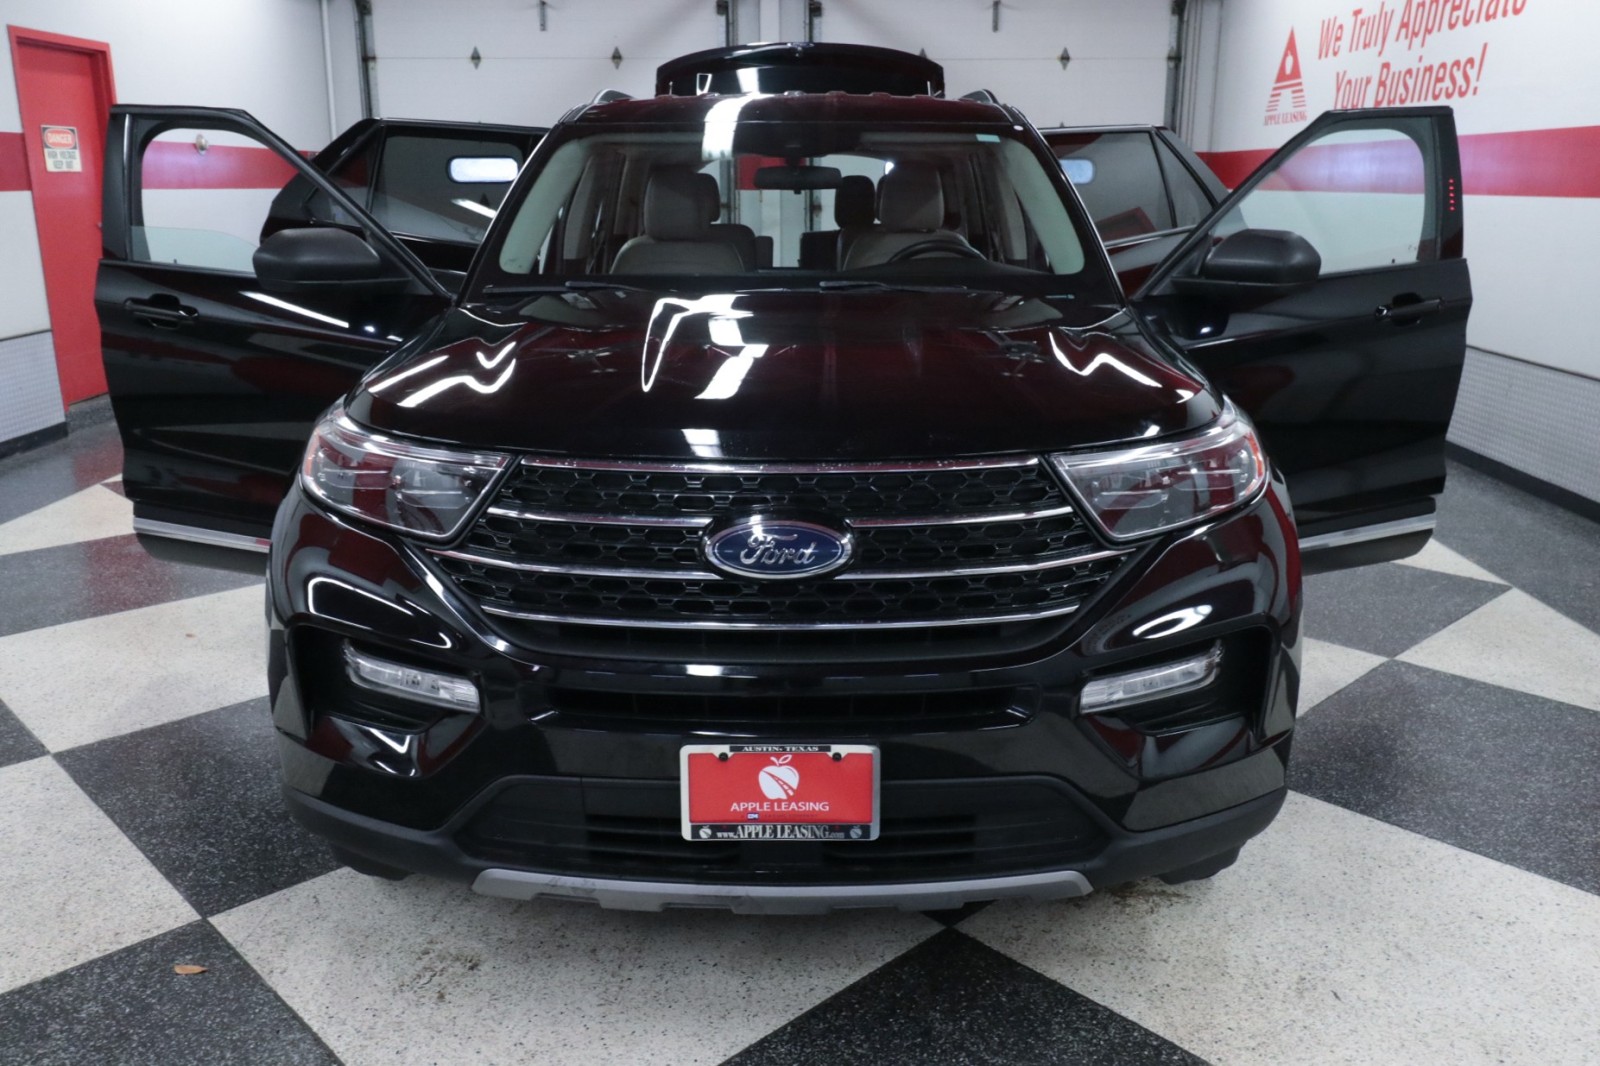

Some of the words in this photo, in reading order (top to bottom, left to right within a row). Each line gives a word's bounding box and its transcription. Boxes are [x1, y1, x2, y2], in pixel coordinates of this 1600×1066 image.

[1318, 16, 1344, 60] We
[1349, 1, 1395, 57] Truly
[1334, 70, 1372, 109] Your
[1374, 42, 1488, 108] Business!
[740, 533, 817, 564] Ford
[730, 802, 771, 812] APPLE
[774, 802, 830, 812] LEASING
[716, 825, 774, 839] www.APPLE
